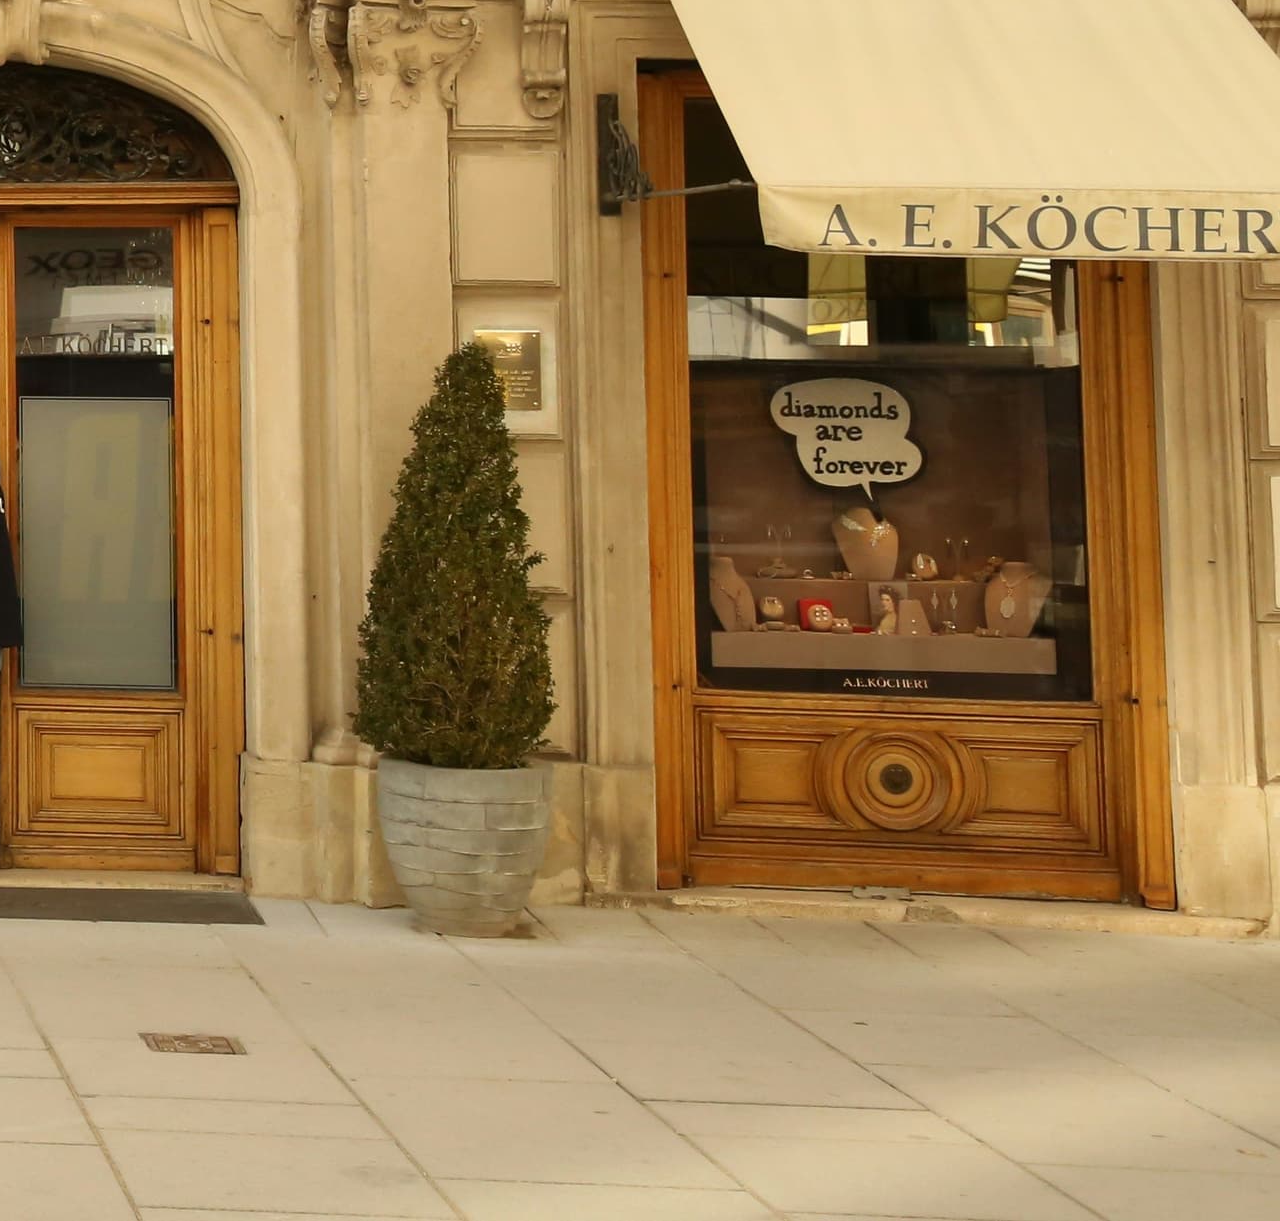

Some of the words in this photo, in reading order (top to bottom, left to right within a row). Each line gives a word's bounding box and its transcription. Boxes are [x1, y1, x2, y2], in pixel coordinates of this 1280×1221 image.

[818, 203, 878, 247] A.
[901, 204, 953, 249] E.
[973, 195, 1280, 254] KÖCHER
[61, 333, 169, 355] KÖCHERT
[780, 392, 899, 421] diamonds
[815, 424, 863, 441] are
[813, 447, 908, 476] forever
